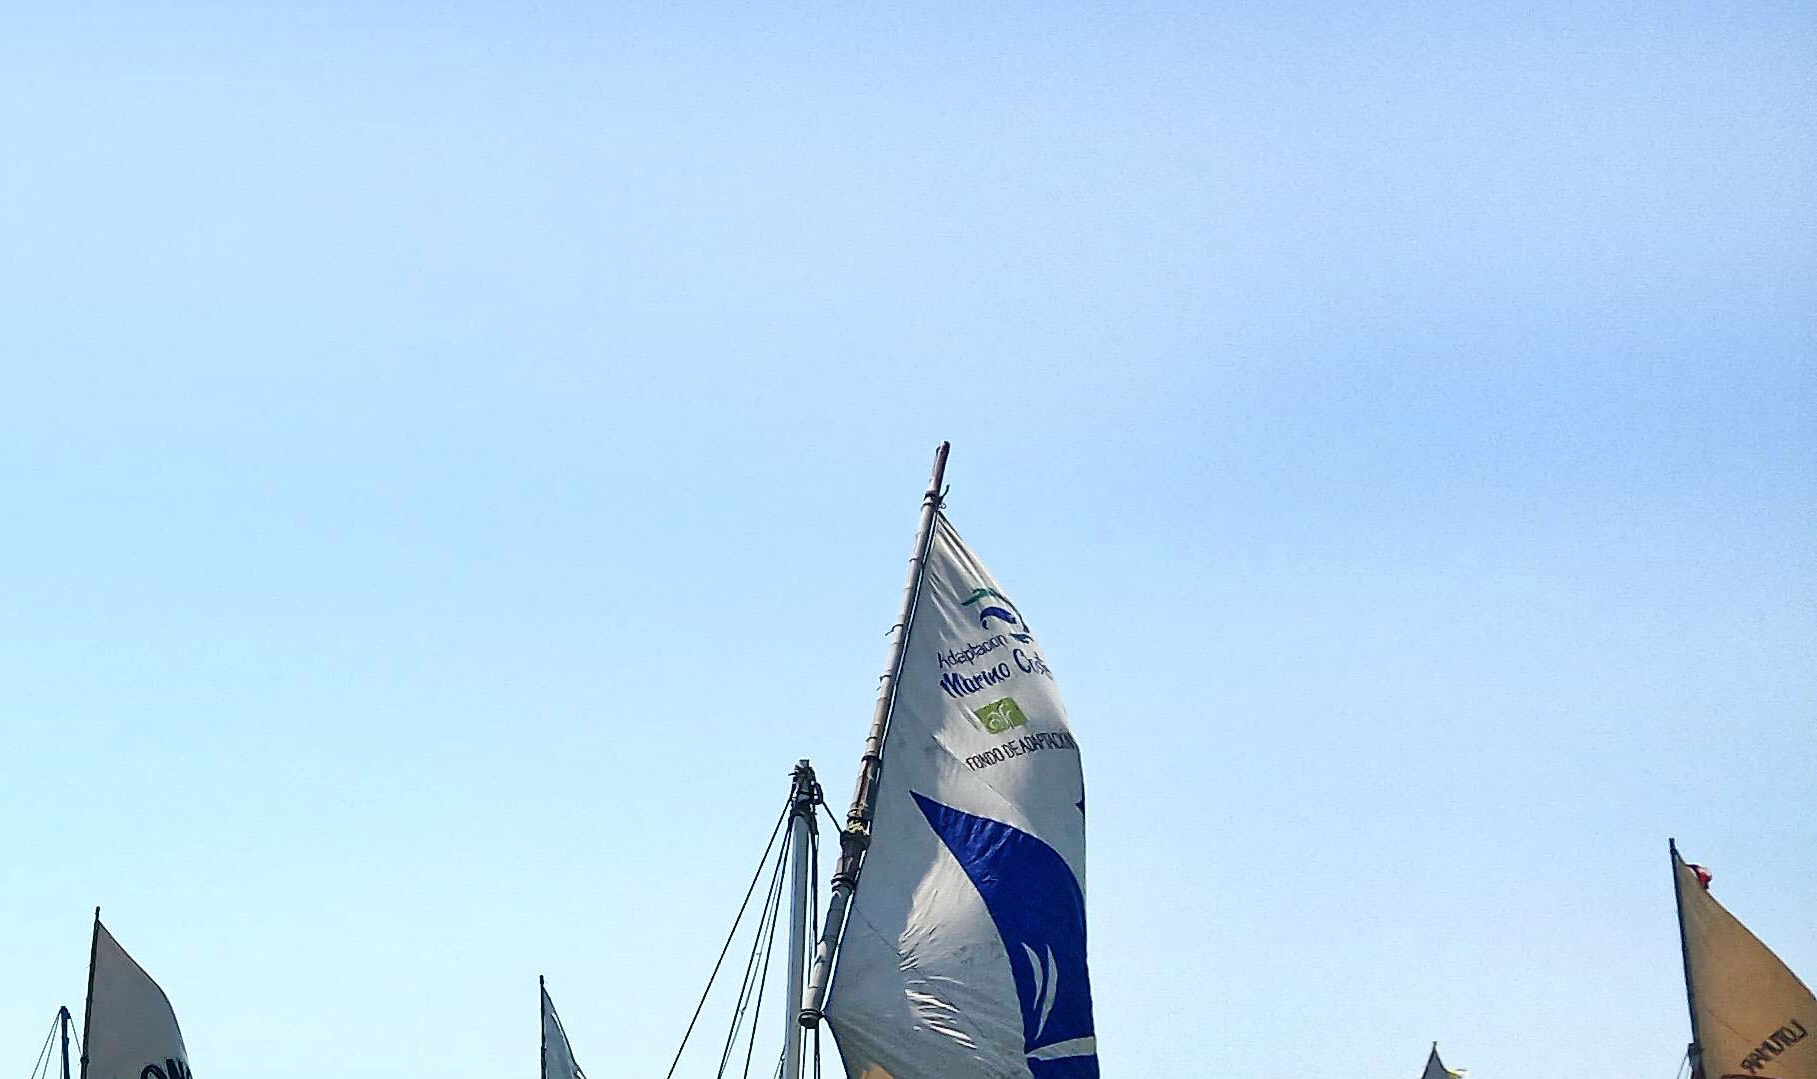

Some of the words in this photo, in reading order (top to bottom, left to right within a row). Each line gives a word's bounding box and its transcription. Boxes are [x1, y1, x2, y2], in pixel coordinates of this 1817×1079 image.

[939, 662, 1012, 699] Marino
[965, 747, 1005, 771] FONDO
[1004, 739, 1023, 760] DE
